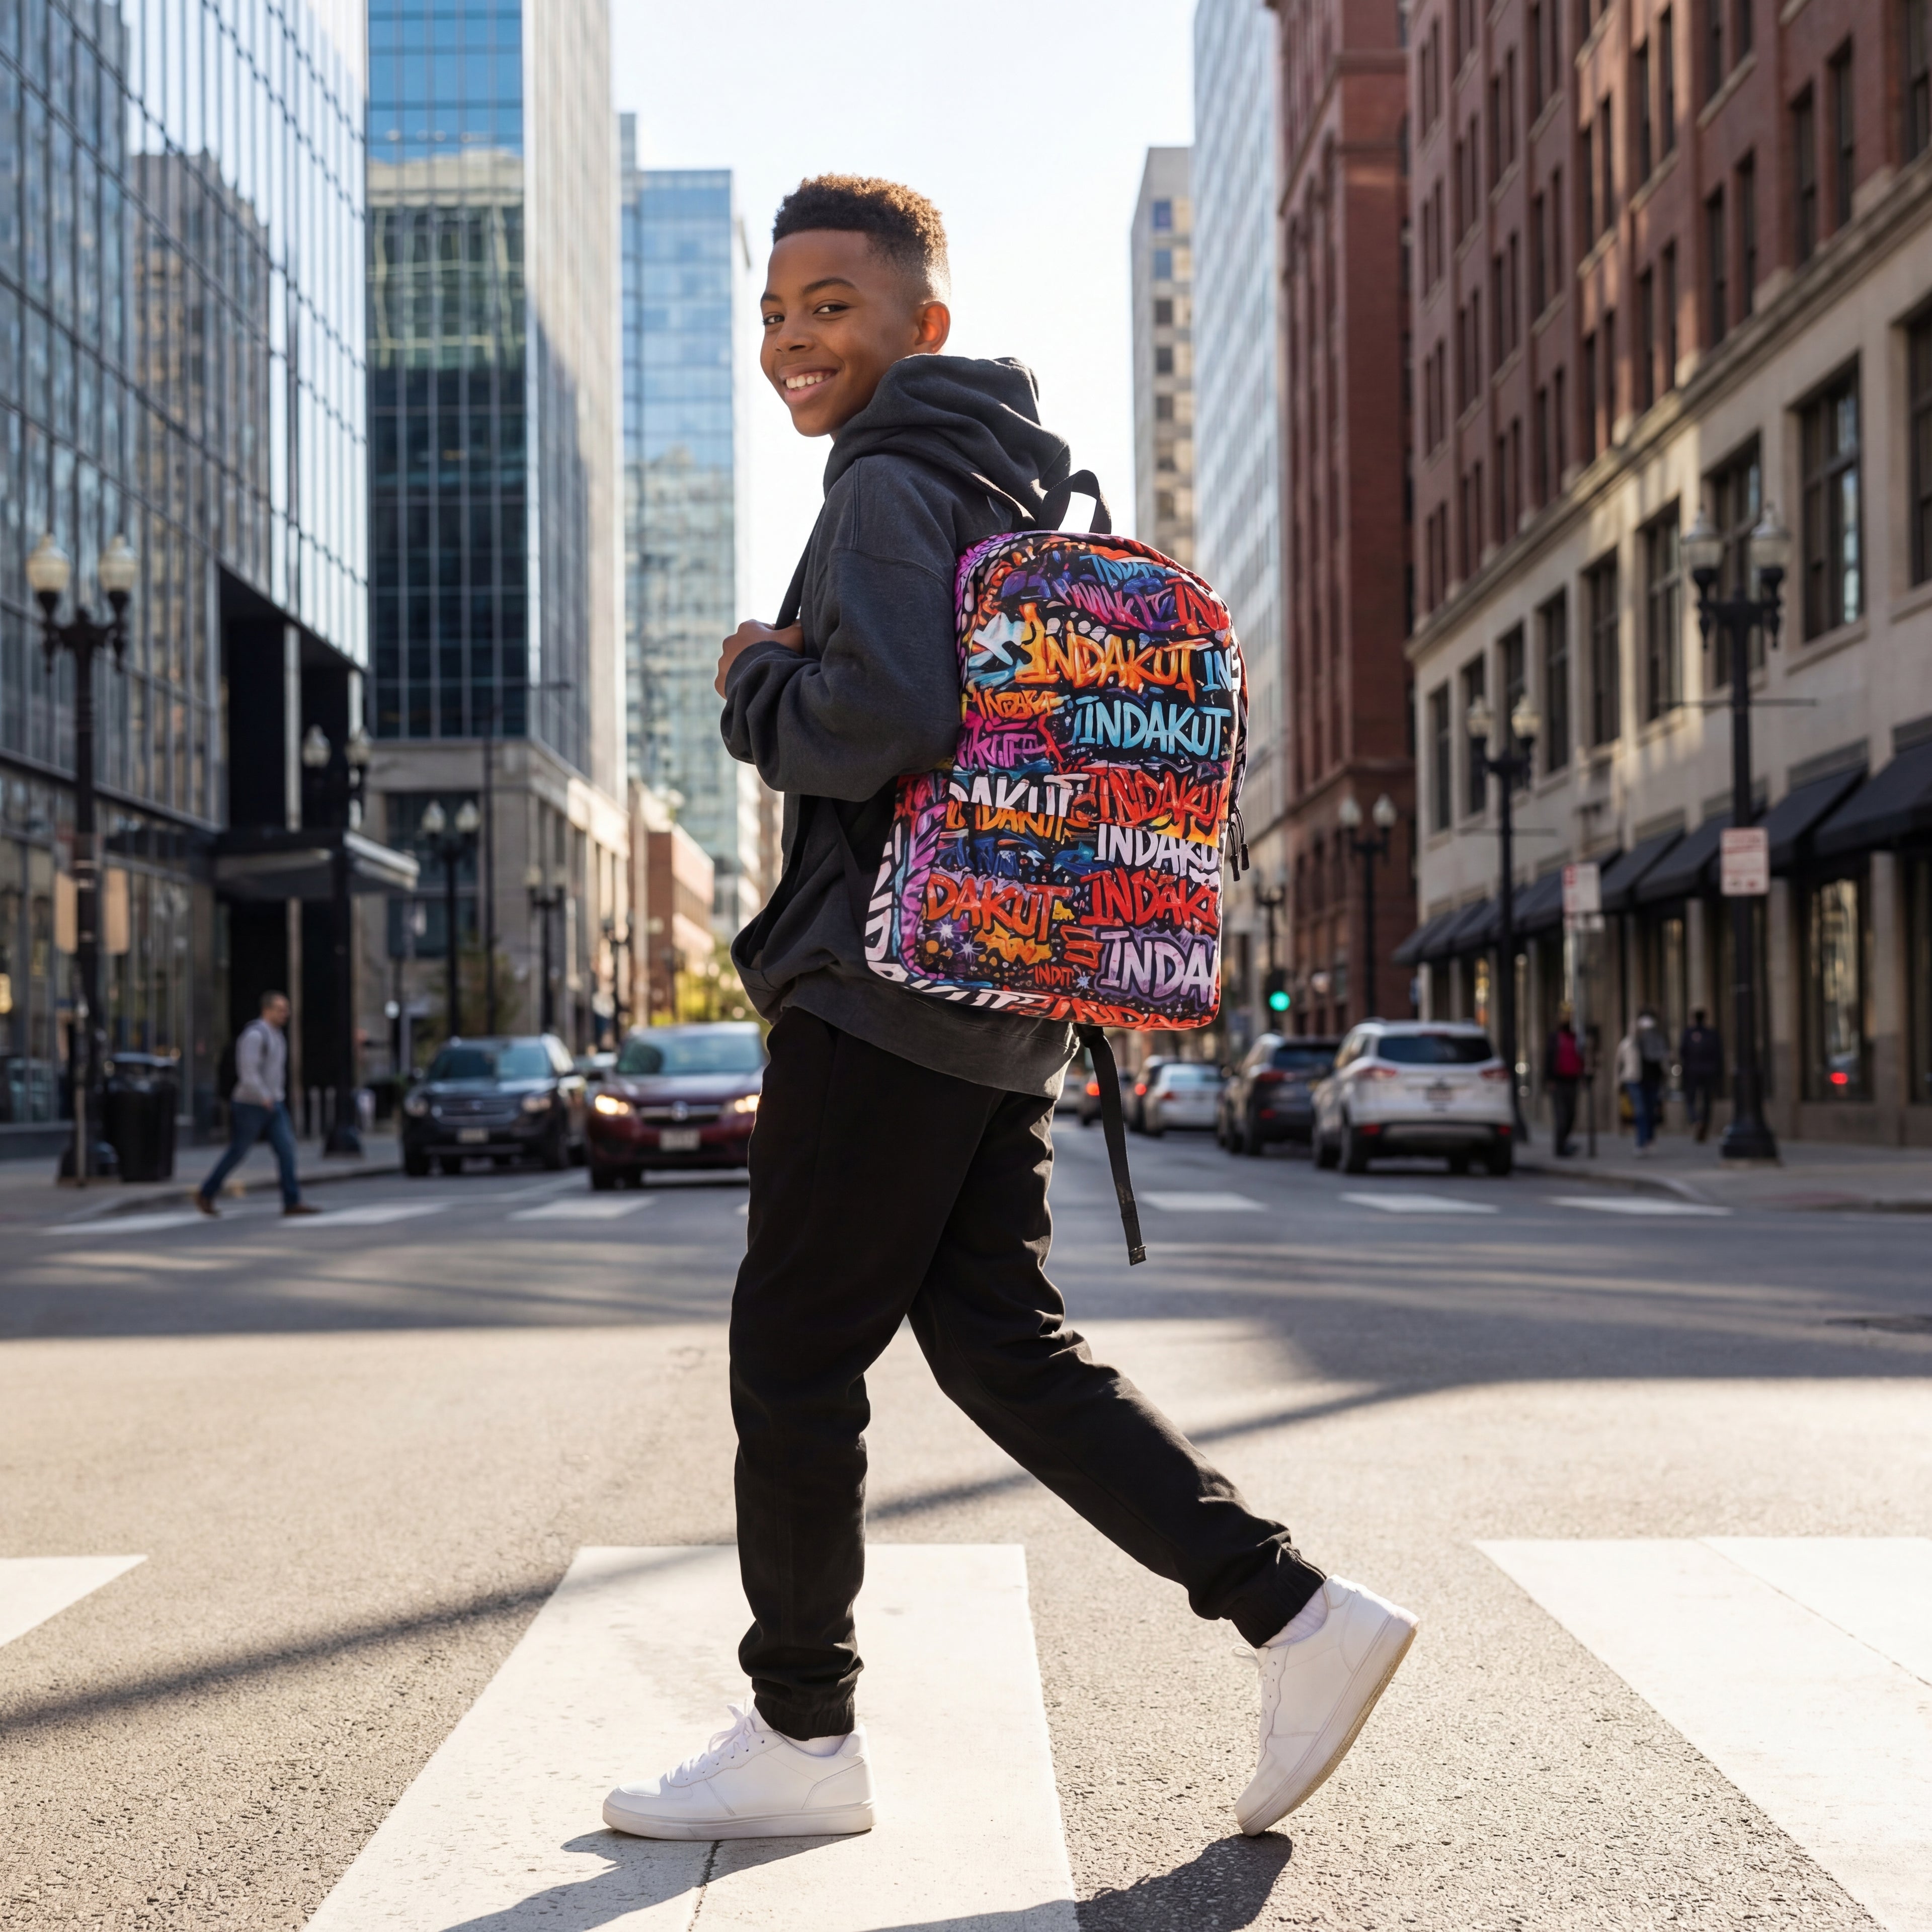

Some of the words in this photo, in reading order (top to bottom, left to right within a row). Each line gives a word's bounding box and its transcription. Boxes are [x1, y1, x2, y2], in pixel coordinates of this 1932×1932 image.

[1015, 602, 1214, 703] INDAKUT
[1075, 695, 1232, 761] INDAKUT
[927, 873, 1073, 941] DAKUT
